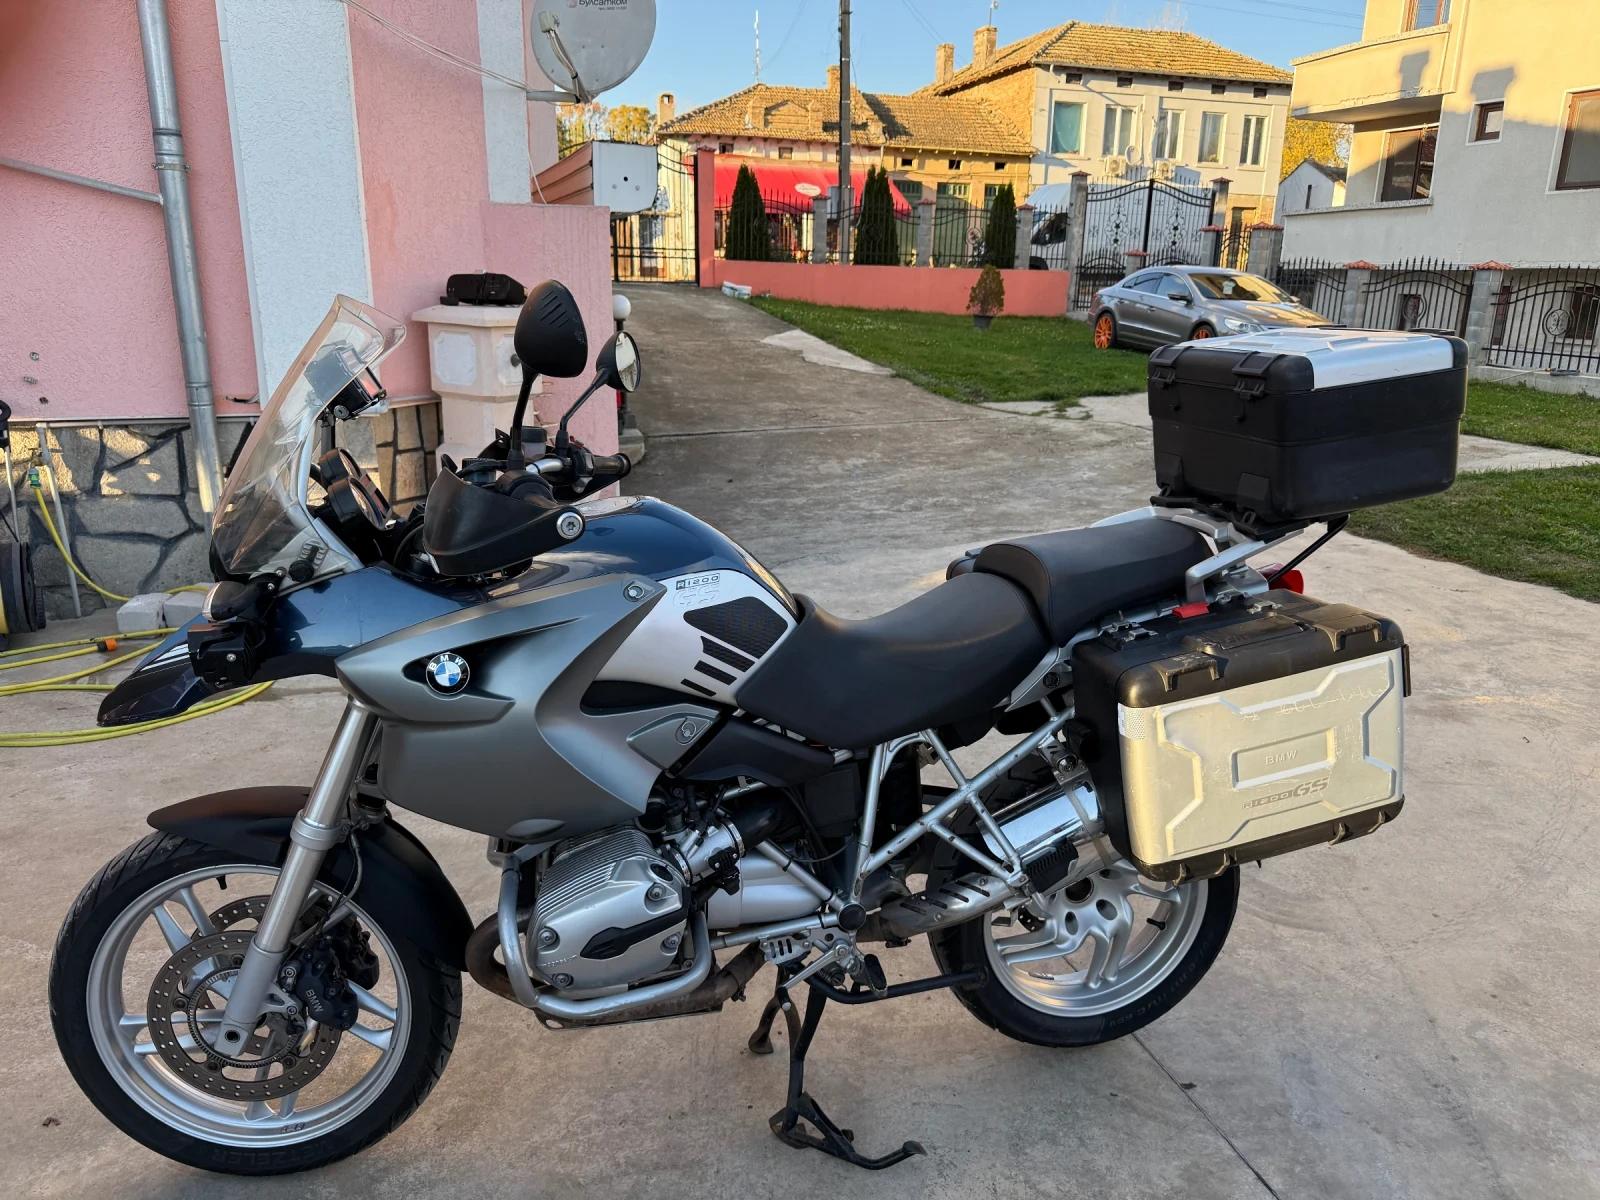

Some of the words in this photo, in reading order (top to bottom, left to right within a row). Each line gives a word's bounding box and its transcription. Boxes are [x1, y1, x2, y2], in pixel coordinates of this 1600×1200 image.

[676, 573, 720, 589] R1200
[428, 655, 464, 671] BMW
[1265, 749, 1298, 765] BMW
[305, 988, 324, 1012] BMW
